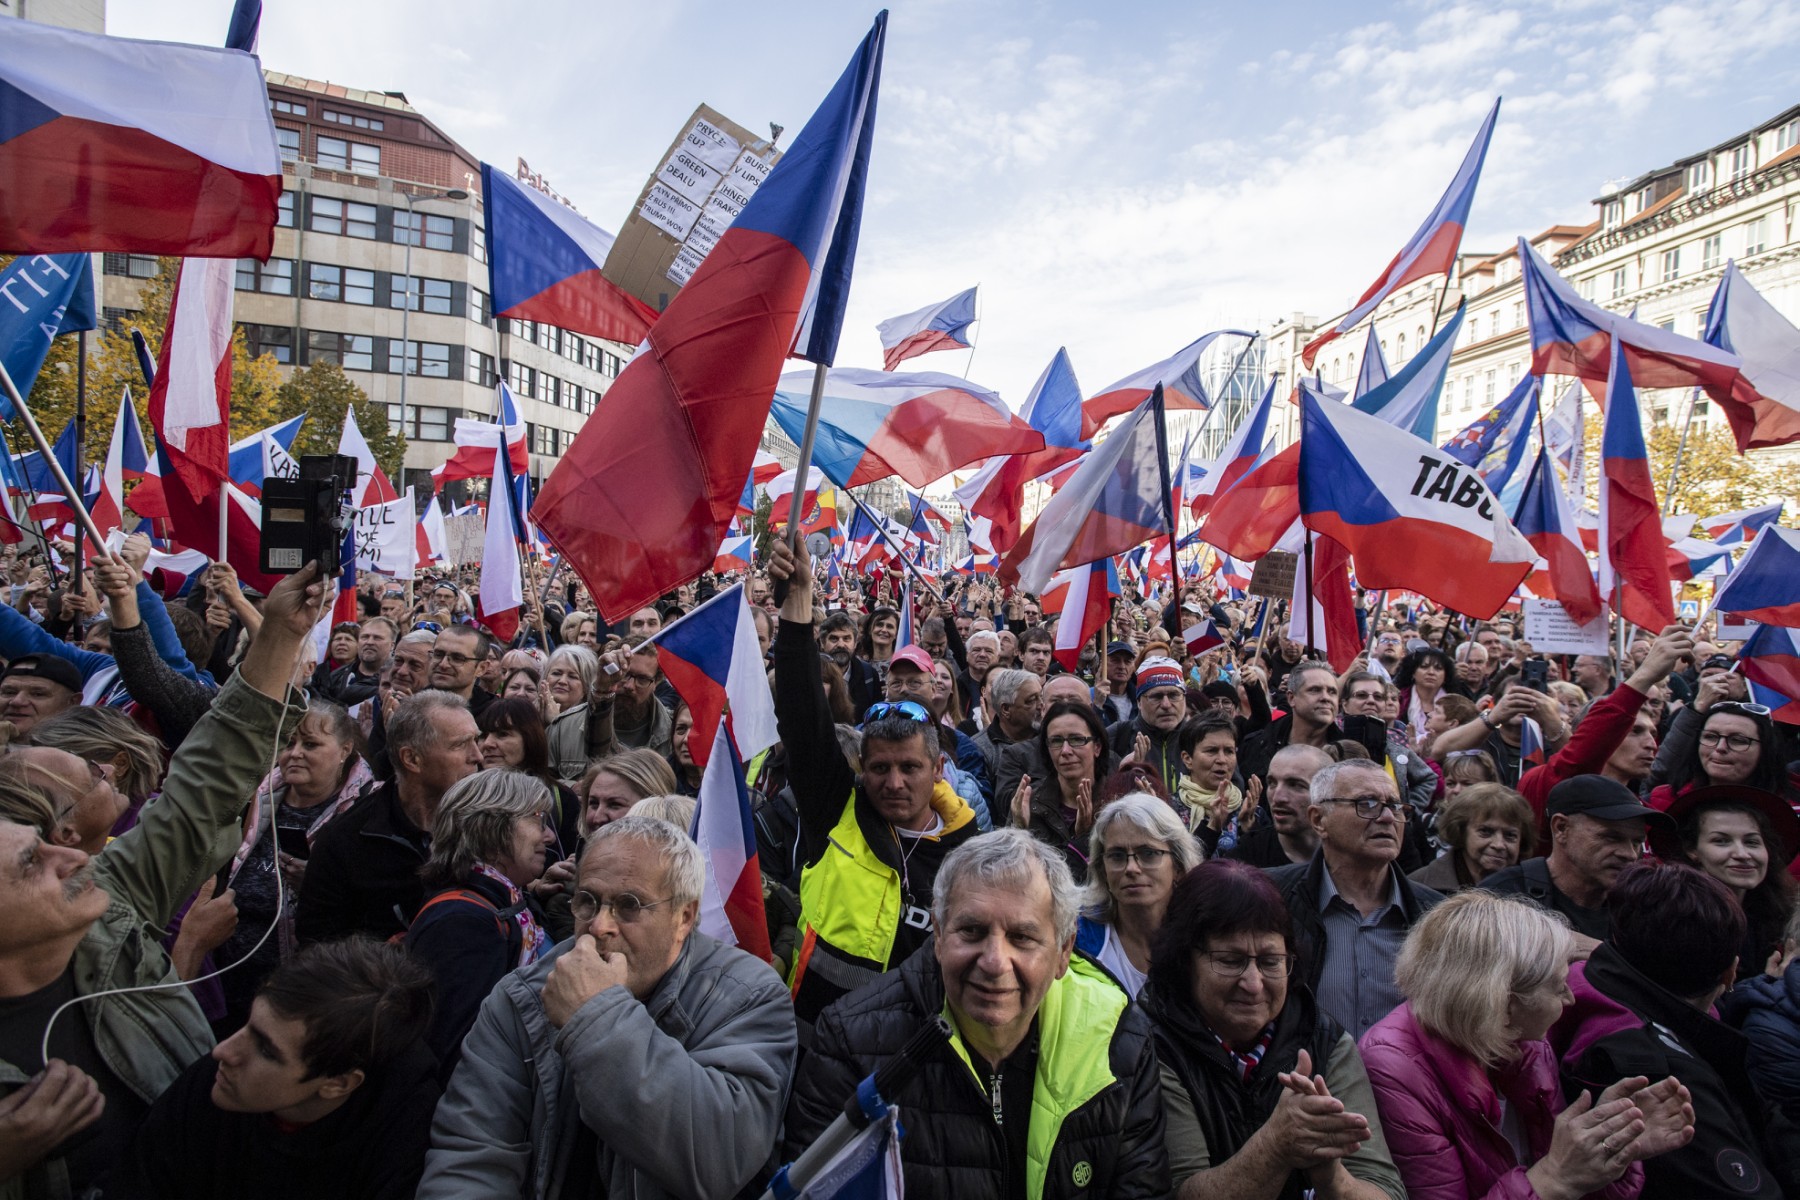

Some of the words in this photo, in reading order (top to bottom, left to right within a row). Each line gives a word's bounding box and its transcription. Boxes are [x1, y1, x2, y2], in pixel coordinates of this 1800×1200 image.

[687, 133, 706, 148] EU?
[696, 121, 720, 140] PRYČ
[666, 164, 696, 187] DEALU
[676, 154, 708, 178] -GREEN
[734, 165, 743, 174] V
[741, 170, 763, 189] LIPS
[647, 193, 654, 201] Z
[653, 197, 667, 209] RUS
[669, 194, 693, 212] PŘÍMO
[712, 197, 740, 219] FRAKO
[643, 203, 667, 221] TRUMP
[666, 218, 684, 233] WON
